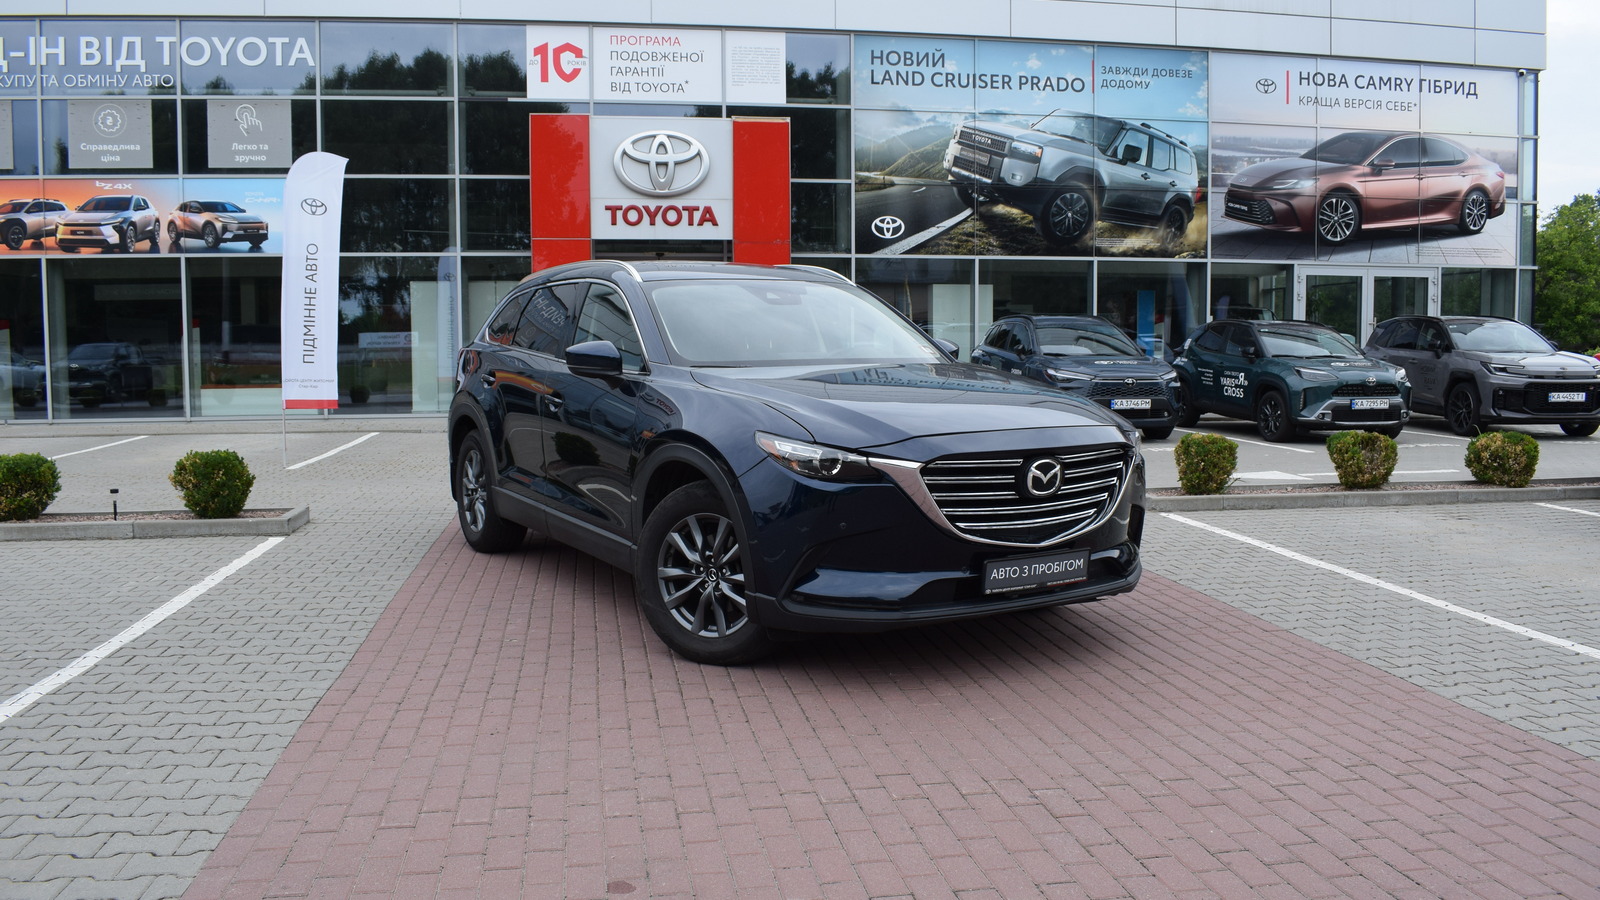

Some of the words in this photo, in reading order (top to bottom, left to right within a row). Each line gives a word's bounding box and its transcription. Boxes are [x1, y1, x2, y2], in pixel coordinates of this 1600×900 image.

[609, 35, 681, 47] ПРОГРАМА
[79, 36, 146, 72] ВІД
[155, 36, 316, 67] TOYOTA
[609, 50, 705, 63] ПОДОВЖЕНОЇ
[870, 48, 946, 68] НОВИЙ
[609, 65, 665, 77] ГАРАНТІЇ
[1100, 65, 1150, 78] ЗАВЖДИ
[1151, 67, 1194, 79] ДОВЕЗЕ
[41, 74, 59, 87] ТА
[63, 74, 128, 87] ОБМІНУ
[132, 74, 174, 87] АВТО
[870, 69, 926, 87] LAND
[930, 71, 1013, 91] CRUISER
[1017, 75, 1086, 93] PRADO
[1100, 78, 1151, 91] ДОДОМУ
[1298, 71, 1349, 89] НОВА
[1354, 74, 1415, 92] CAMRY
[1418, 78, 1479, 99] ГІБРИД
[609, 82, 632, 94] ВІД
[1298, 95, 1342, 108] КРАЩА
[1343, 98, 1383, 110] ВЕРСІЯ
[971, 135, 992, 144] TOYOTA
[80, 142, 141, 152] Справедлива
[231, 142, 255, 152] Легко
[100, 153, 121, 163] ціна
[234, 153, 267, 163] зручно
[604, 204, 719, 227] TOYOTA
[304, 243, 319, 283] АВТО
[302, 287, 318, 364] ПІДМІННЕ
[1220, 377, 1235, 387] YARIS
[1223, 386, 1244, 398] CROSS
[1354, 400, 1365, 408] KA
[1366, 400, 1378, 408] 7295
[1379, 400, 1388, 408] PH
[990, 566, 1020, 580] АВТО
[1022, 565, 1029, 577] З
[1031, 558, 1084, 576] ПРОБІГОМ
